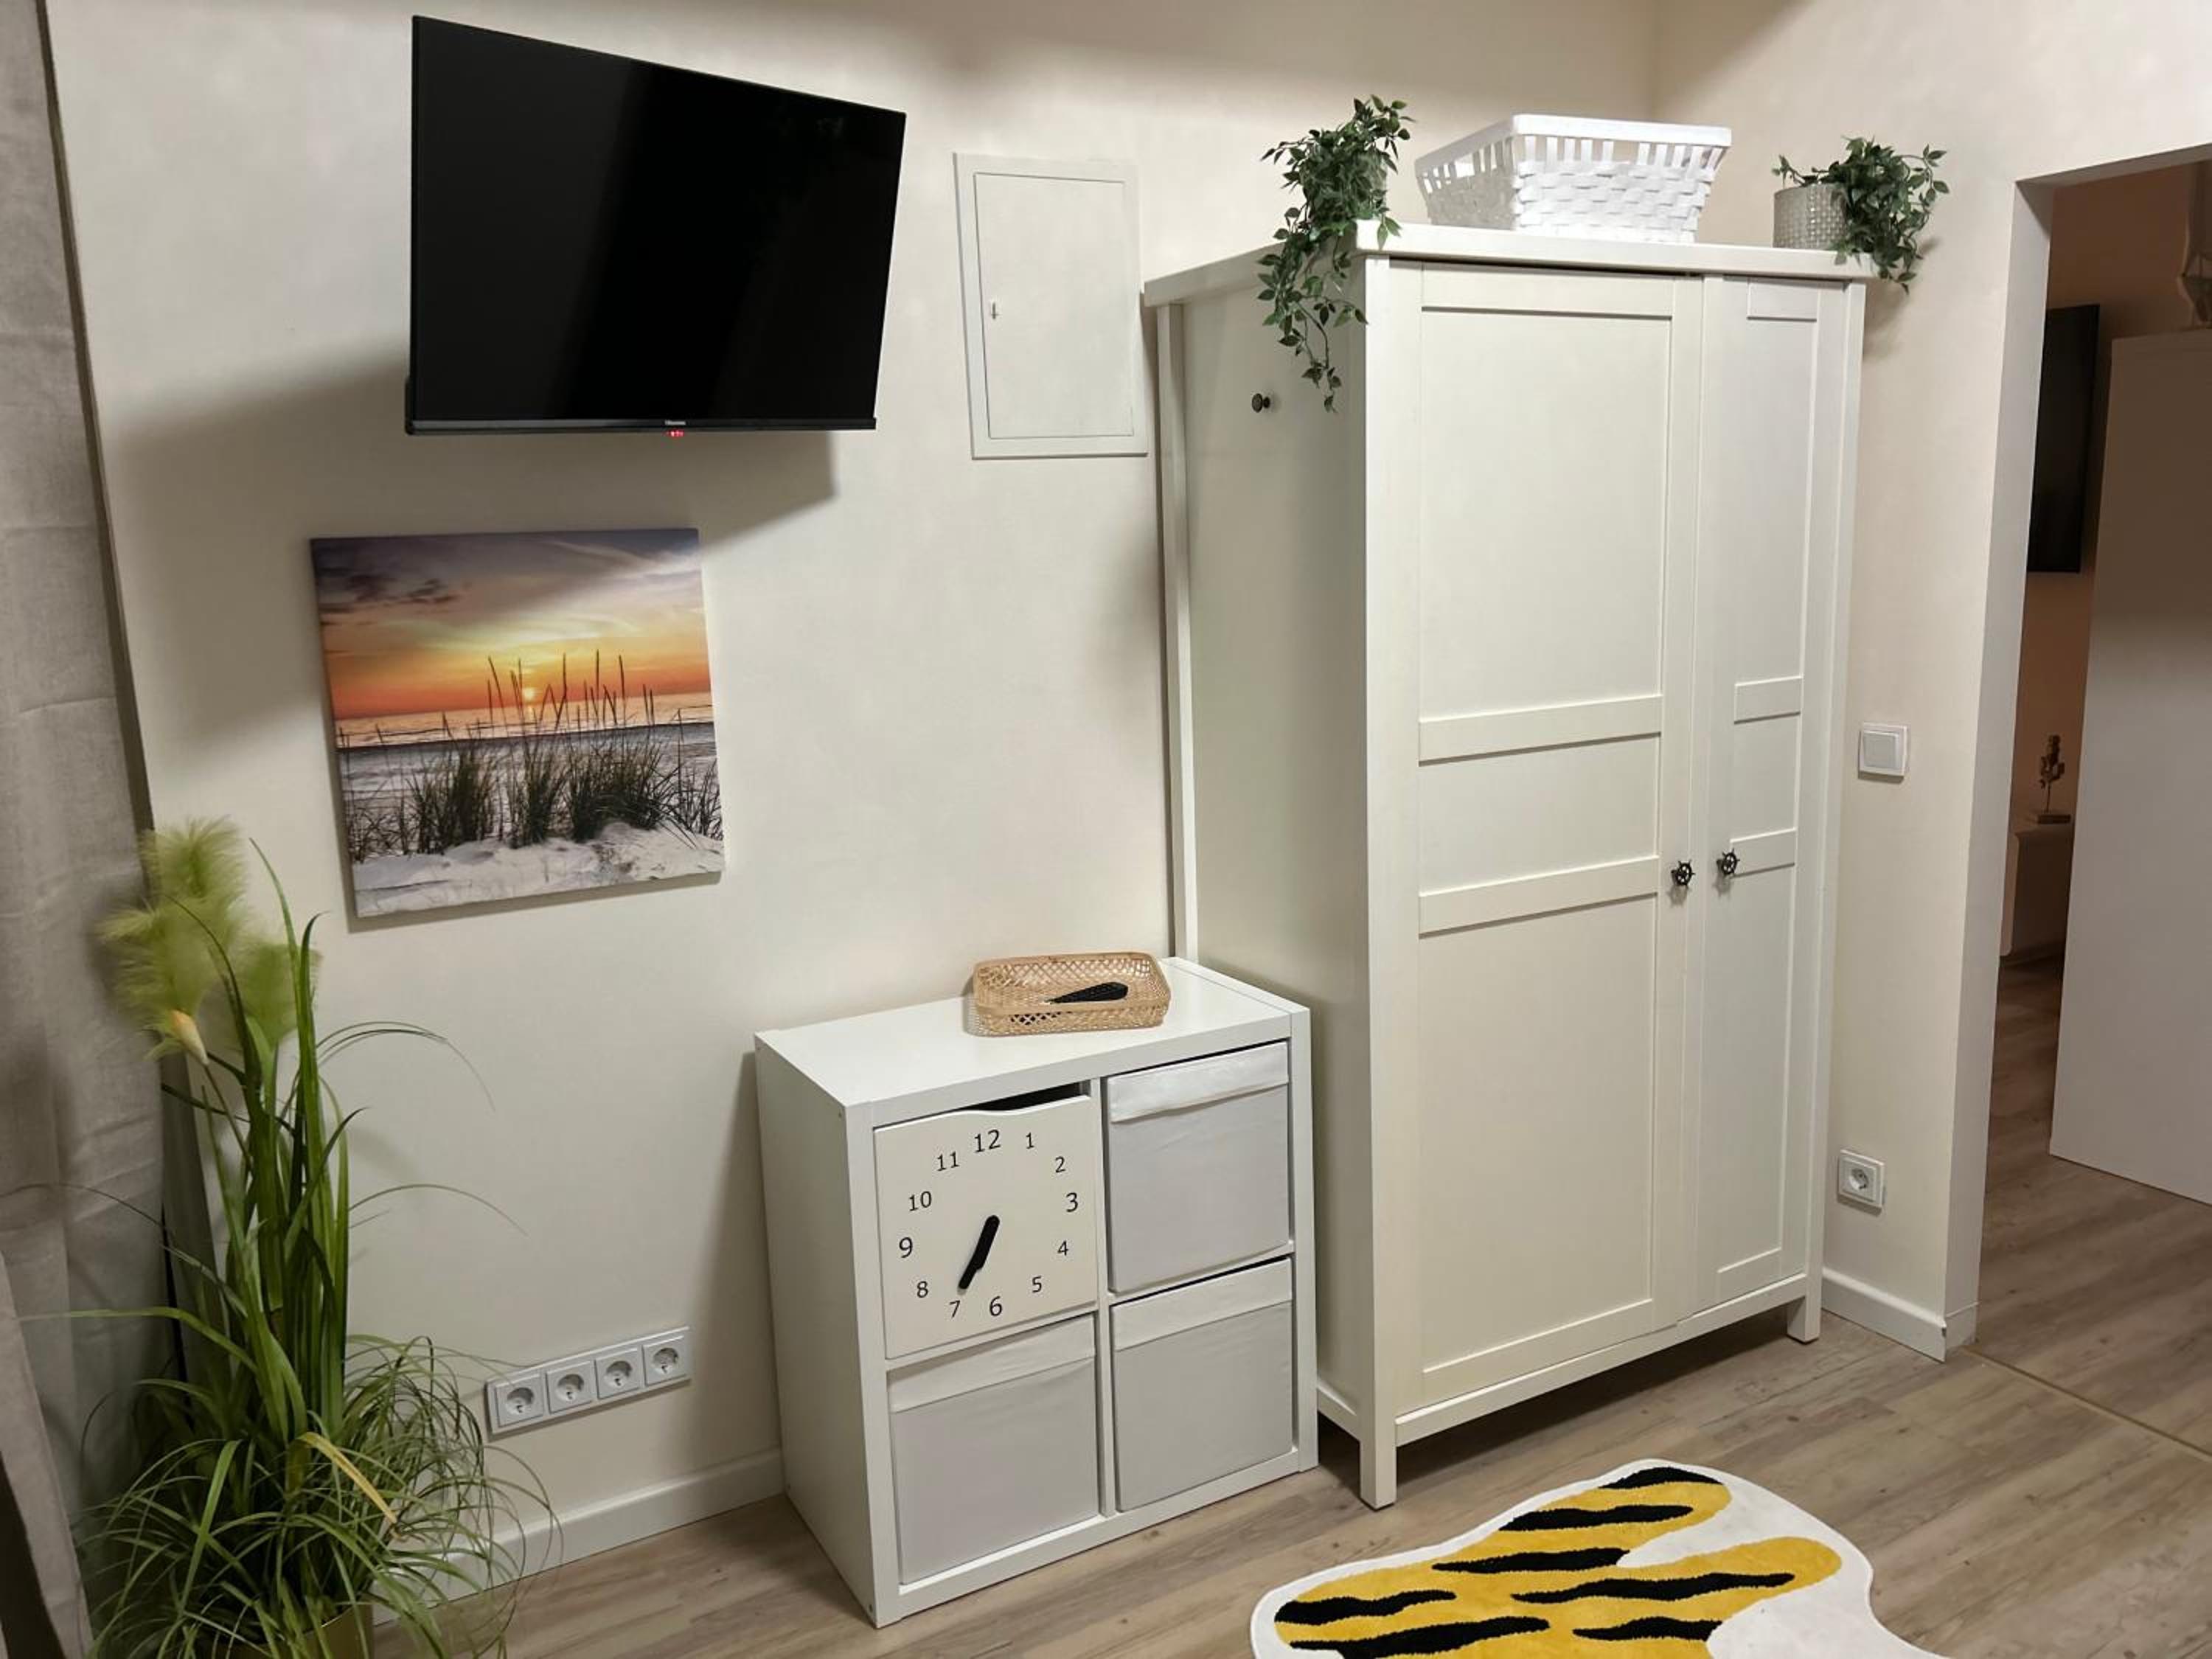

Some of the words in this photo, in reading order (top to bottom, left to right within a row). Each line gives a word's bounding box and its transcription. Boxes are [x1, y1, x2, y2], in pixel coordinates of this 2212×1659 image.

[974, 1129, 1001, 1153] 12
[1026, 1132, 1034, 1150] 1
[936, 1151, 959, 1172] 11
[1055, 1155, 1066, 1174] 2
[908, 1191, 933, 1212] 10
[1065, 1192, 1079, 1213] 3
[898, 1237, 914, 1259] 9
[1057, 1240, 1069, 1256] 4
[917, 1280, 929, 1298] 8
[1032, 1275, 1043, 1294] 5
[949, 1299, 961, 1318] 7
[989, 1295, 1003, 1317] 6
